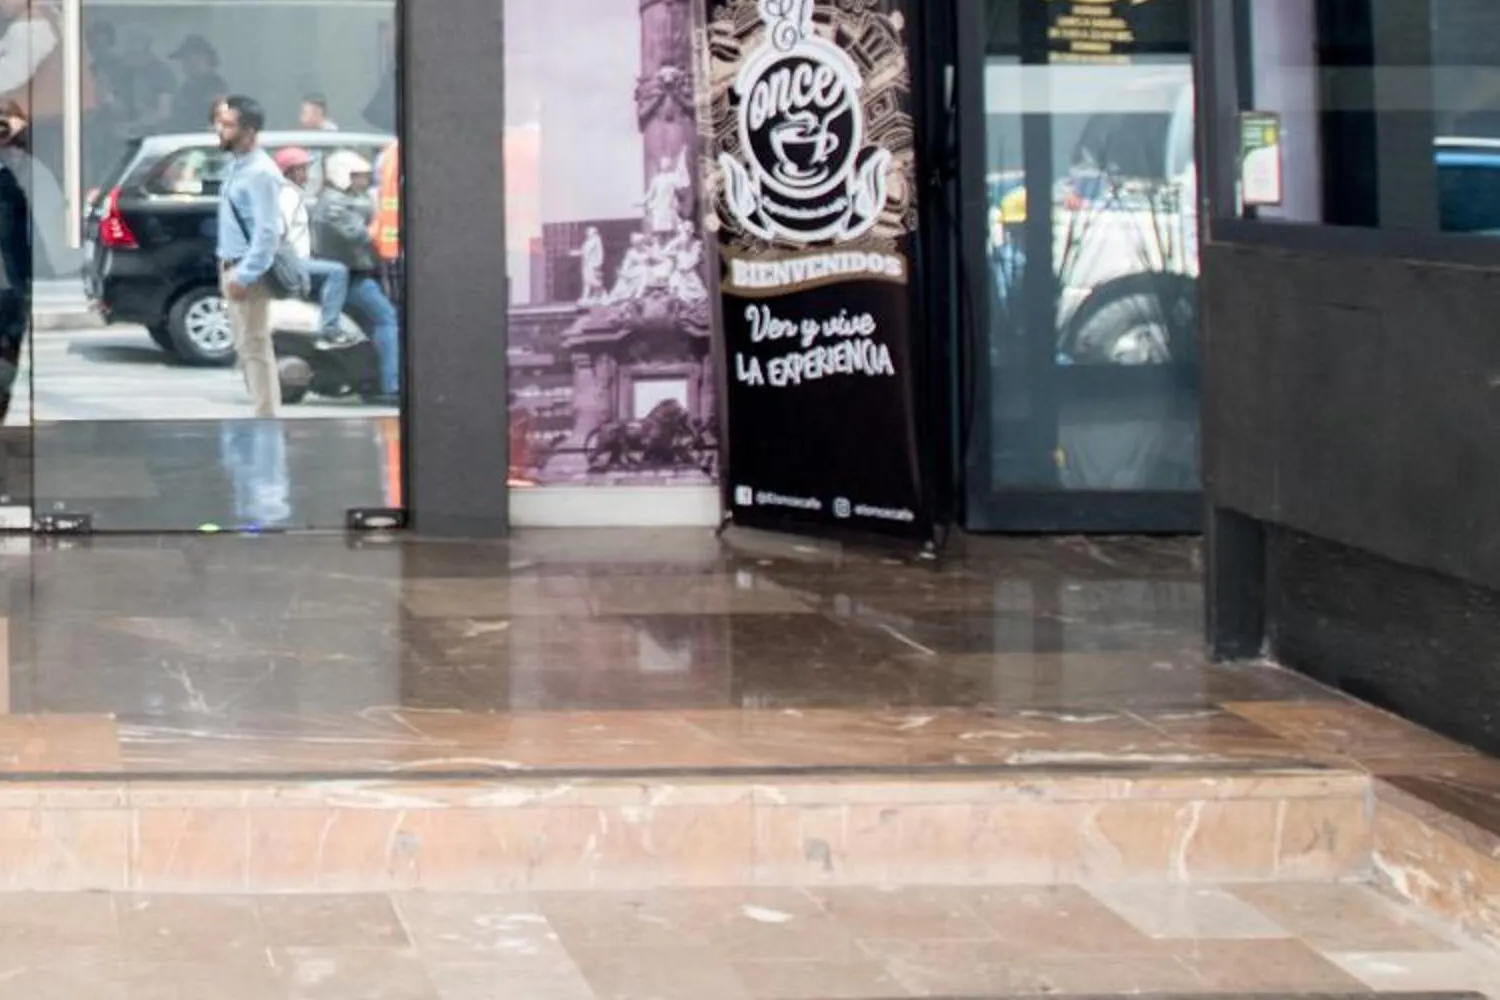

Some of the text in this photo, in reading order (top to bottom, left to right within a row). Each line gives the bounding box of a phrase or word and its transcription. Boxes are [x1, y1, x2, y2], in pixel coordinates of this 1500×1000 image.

[749, 63, 844, 131] once
[731, 251, 903, 287] BIENVENIDOS
[800, 317, 821, 347] y
[821, 308, 877, 337] vive
[735, 337, 896, 387] LA EXPERIENCIA
